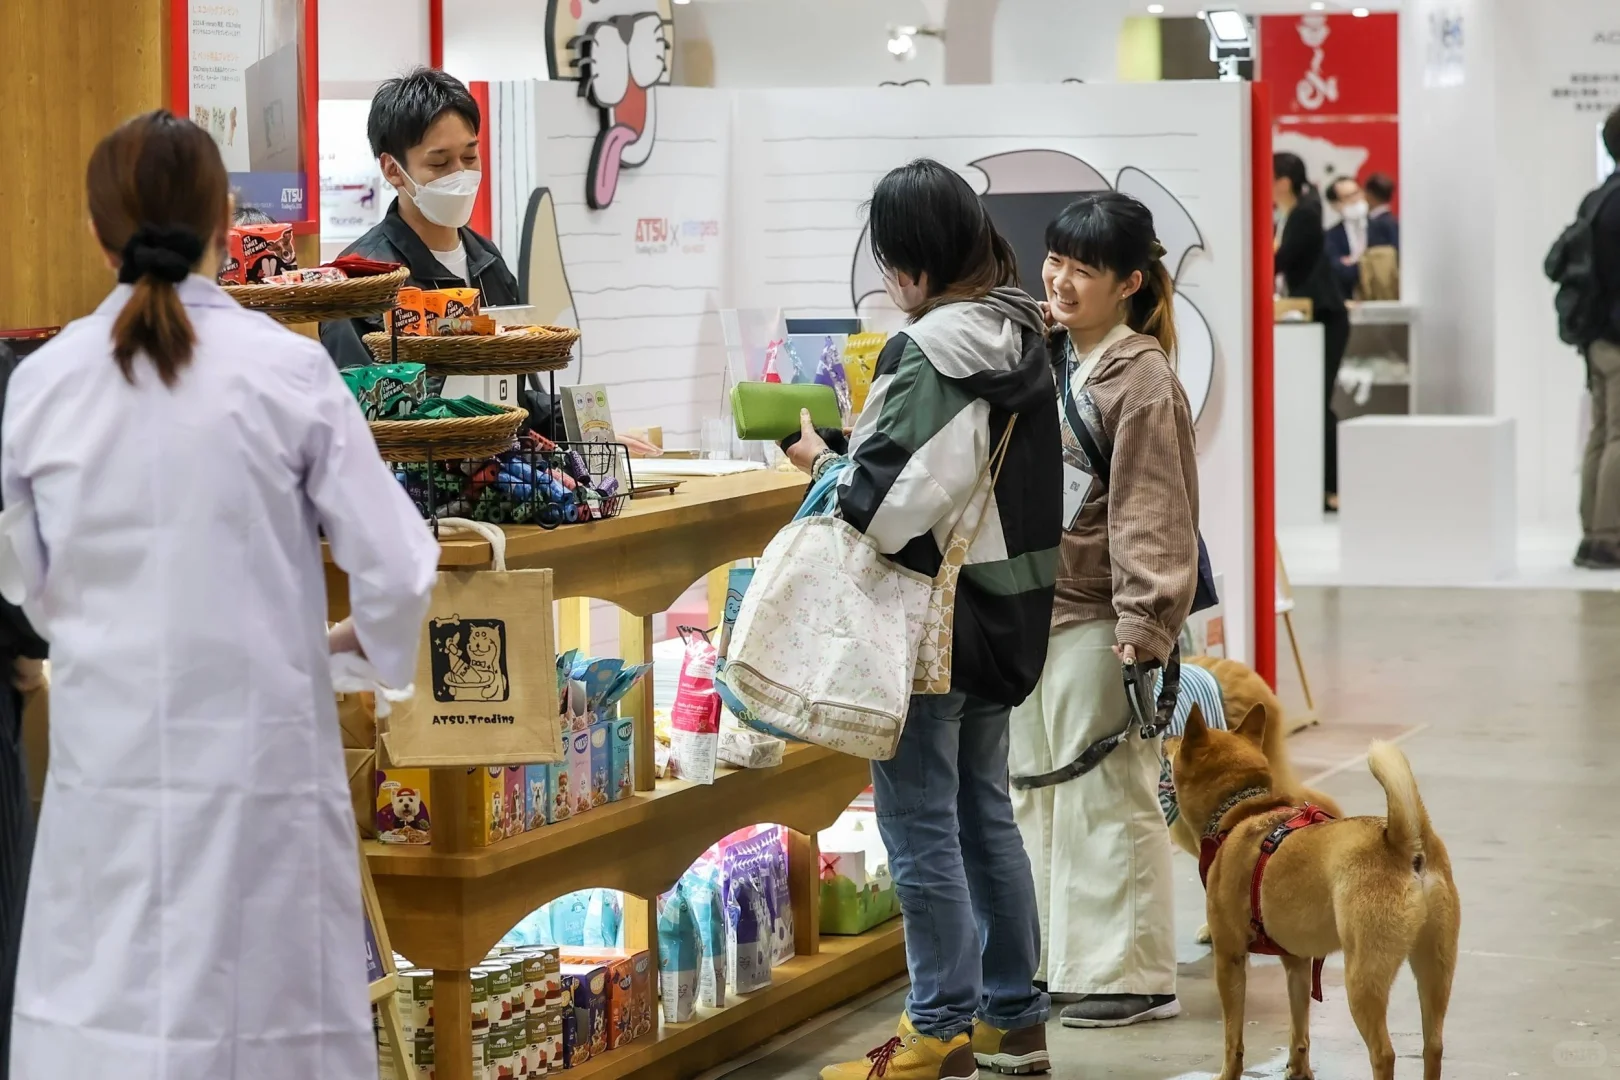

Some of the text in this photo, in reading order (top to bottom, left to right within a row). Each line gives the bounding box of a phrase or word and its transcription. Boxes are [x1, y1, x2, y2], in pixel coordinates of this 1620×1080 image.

[281, 188, 303, 203] ATSU
[635, 218, 668, 242] ATSU
[432, 714, 515, 726] ATSU.Trading
